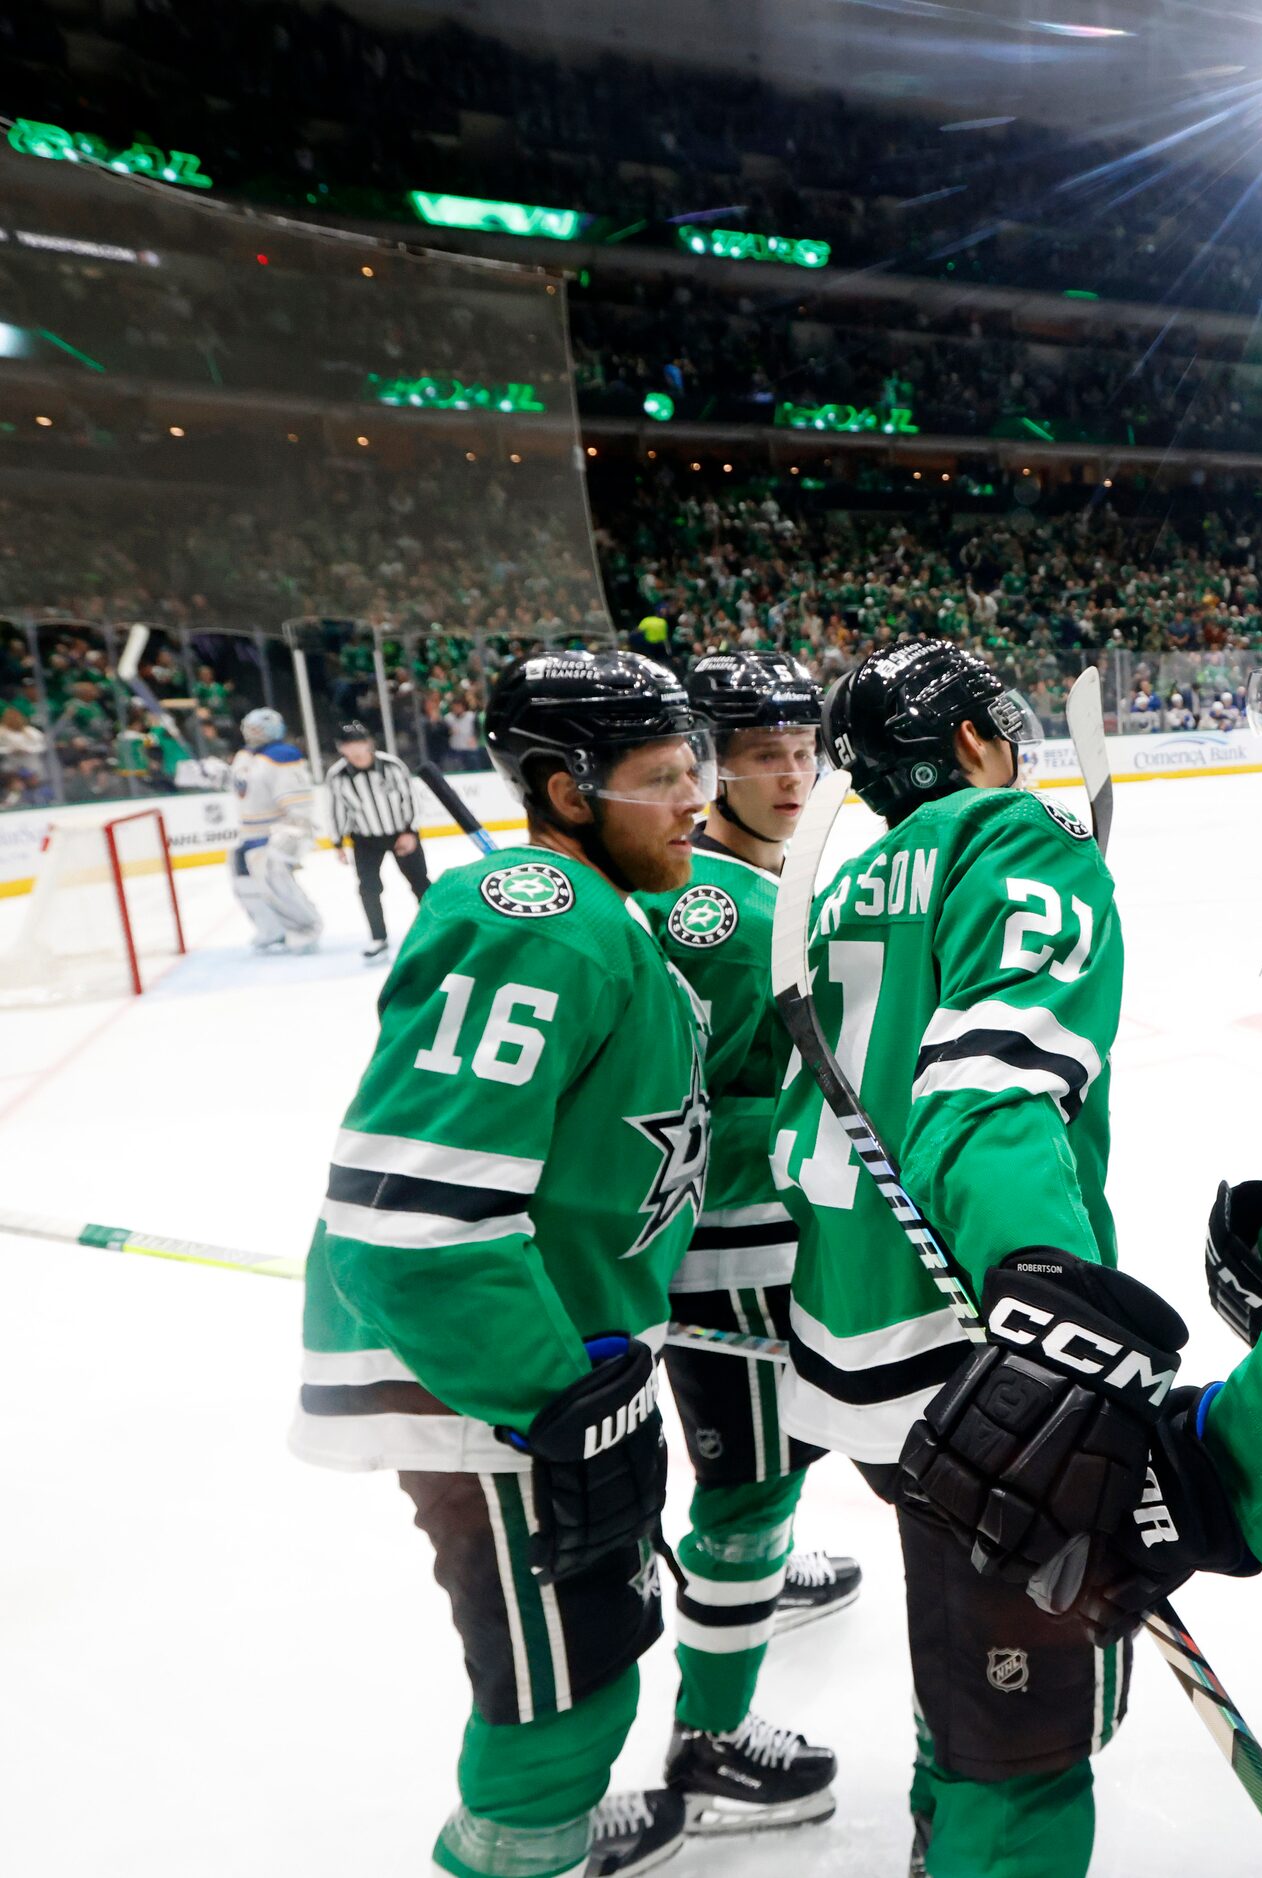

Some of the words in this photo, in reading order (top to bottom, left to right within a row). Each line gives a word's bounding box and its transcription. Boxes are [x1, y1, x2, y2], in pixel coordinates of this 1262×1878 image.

[544, 669, 601, 680] TRANSFER
[545, 660, 593, 670] ENERGY
[773, 664, 796, 683] 5
[834, 733, 857, 768] 21
[1211, 744, 1248, 761] Bank
[1044, 758, 1077, 769] TEXA
[494, 866, 570, 898] DALLAS
[488, 887, 559, 913] STARS
[675, 889, 734, 917] DALLAS
[672, 923, 727, 943] STARS
[1000, 876, 1094, 984] 21
[413, 972, 560, 1087] 16
[1016, 1262, 1064, 1275] ROBERTSON
[988, 1295, 1178, 1407] CCM
